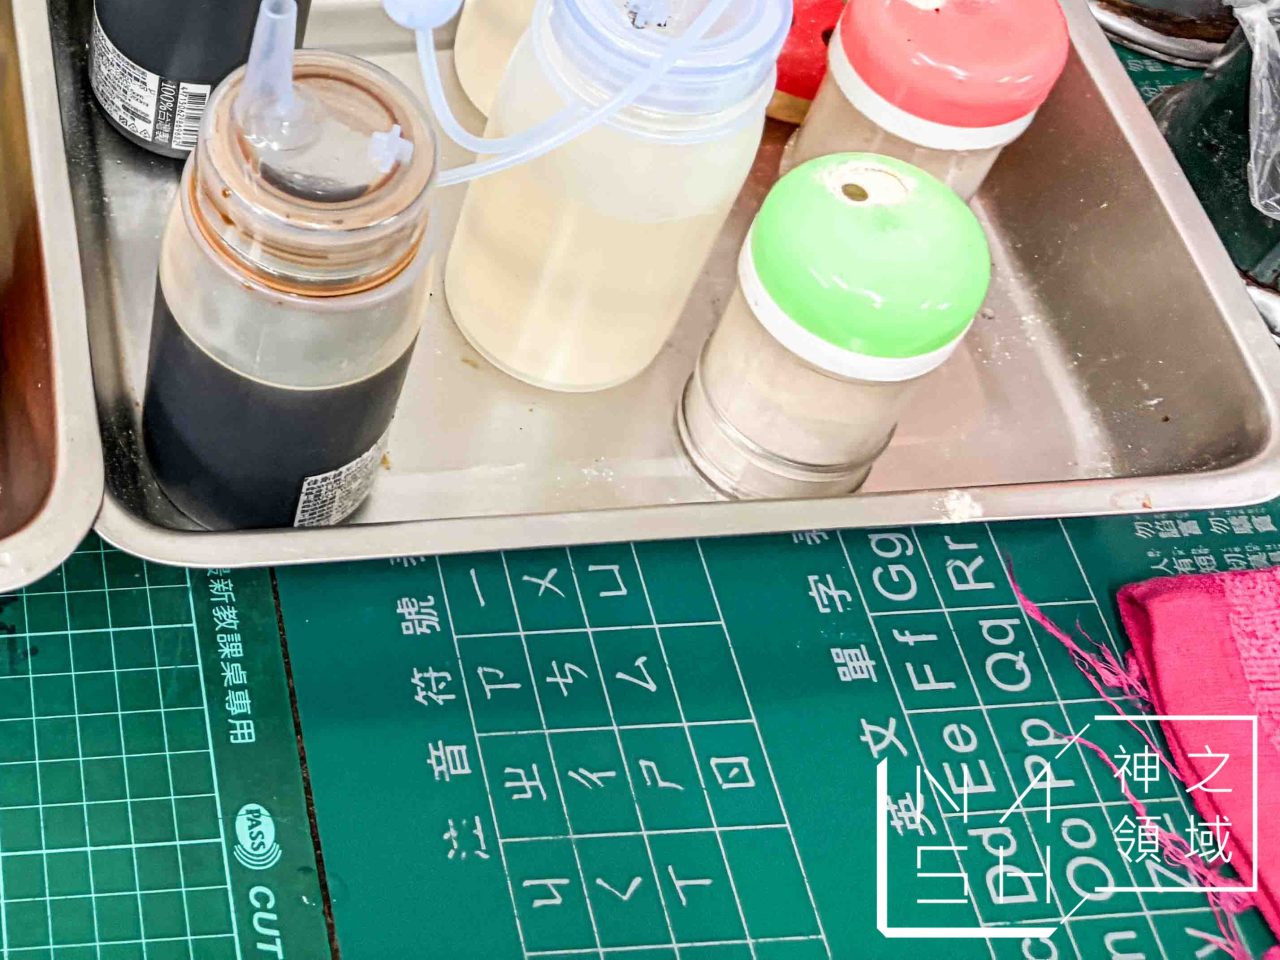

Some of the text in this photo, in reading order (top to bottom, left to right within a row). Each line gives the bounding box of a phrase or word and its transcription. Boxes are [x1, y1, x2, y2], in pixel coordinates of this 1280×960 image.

[243, 808, 267, 853] PASS
[868, 533, 1038, 904] Dd Ee Ff Gg
[943, 536, 1114, 901] Oo Pp Qq Rr
